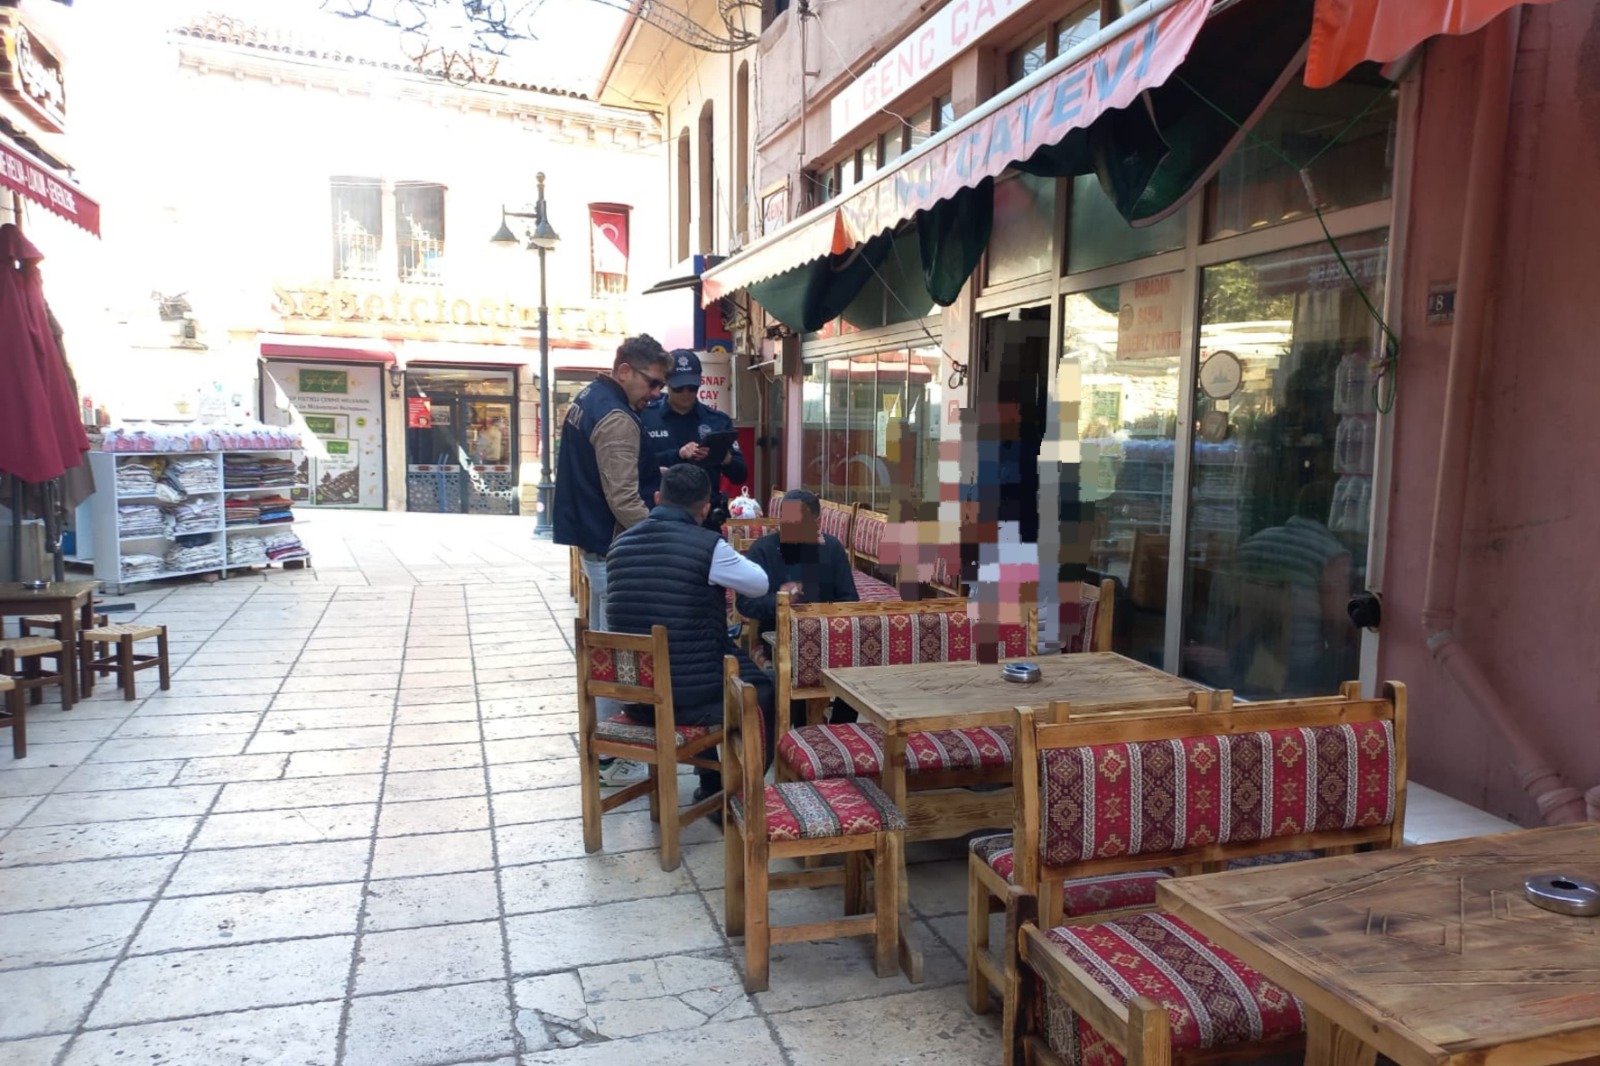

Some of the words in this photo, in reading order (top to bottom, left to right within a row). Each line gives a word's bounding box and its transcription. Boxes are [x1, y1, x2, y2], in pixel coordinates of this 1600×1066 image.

[1435, 295, 1444, 311] 8
[700, 376, 726, 386] SNAF
[648, 430, 669, 438] OLİS
